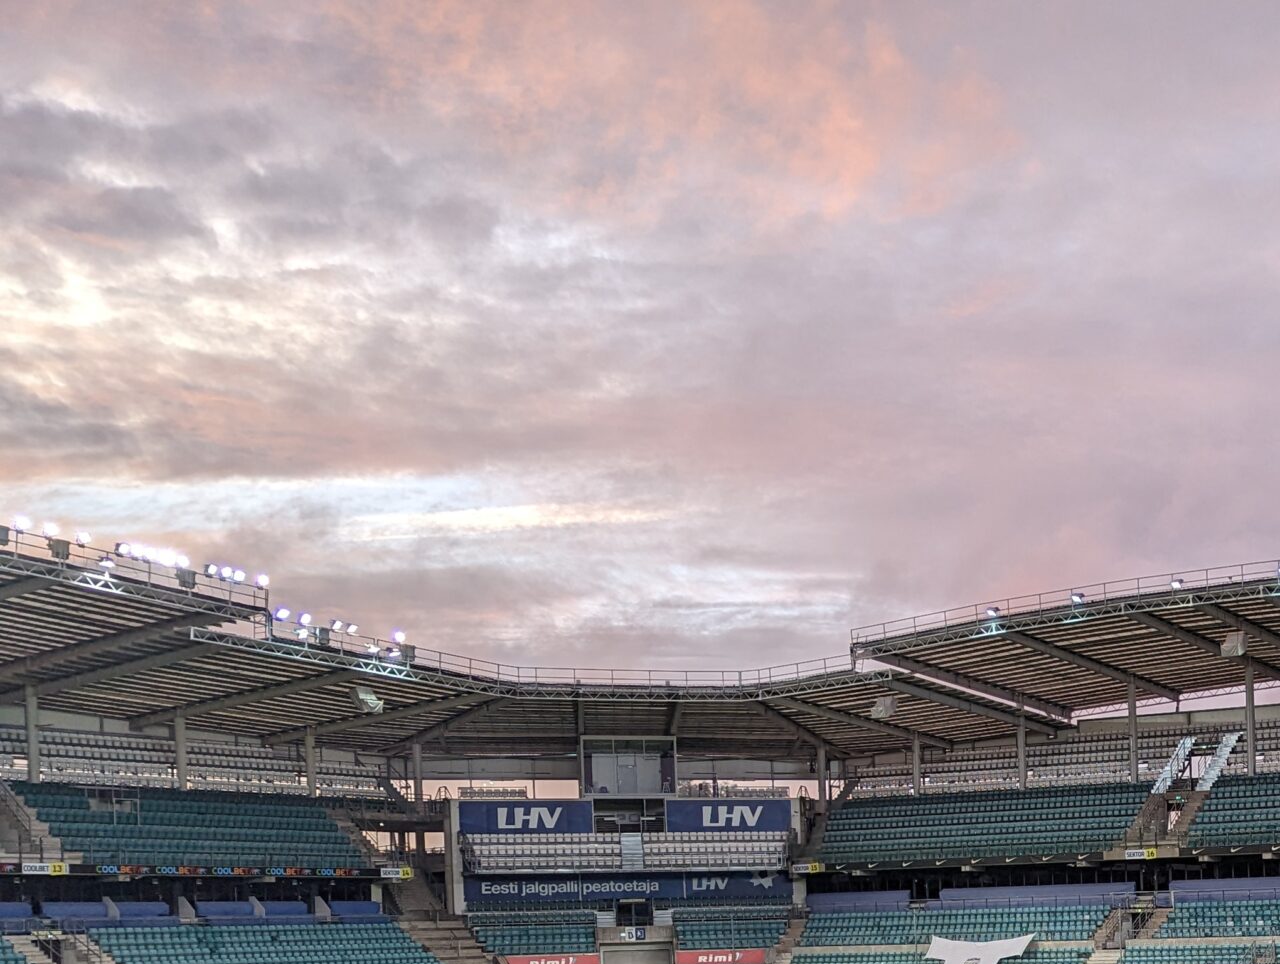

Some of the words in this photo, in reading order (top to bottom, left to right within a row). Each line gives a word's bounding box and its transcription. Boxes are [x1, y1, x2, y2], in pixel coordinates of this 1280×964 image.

[497, 806, 563, 829] LHV
[702, 805, 764, 827] LHV
[1146, 850, 1155, 858] 16
[52, 864, 63, 873] 13
[402, 869, 410, 877] 14
[481, 881, 519, 895] Eesti
[521, 880, 578, 898] jalgpalli
[582, 879, 660, 898] peatoetaja
[692, 877, 729, 891] LHV
